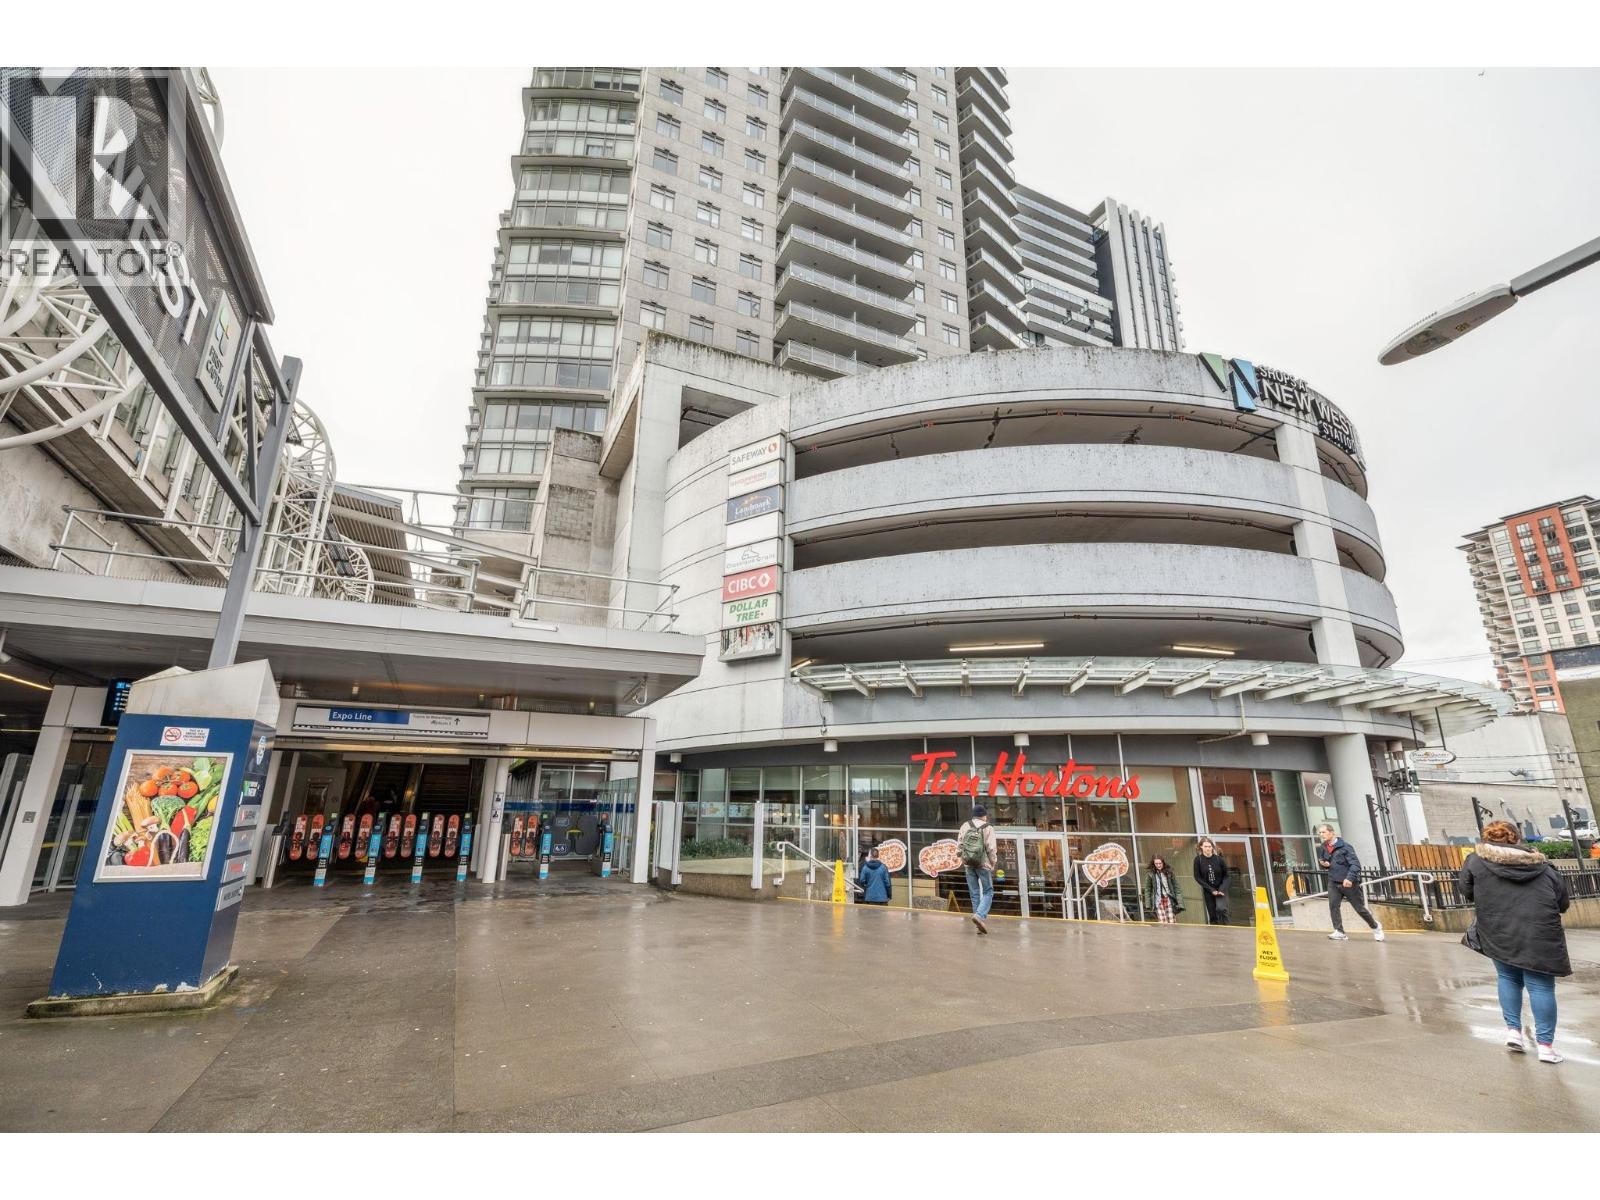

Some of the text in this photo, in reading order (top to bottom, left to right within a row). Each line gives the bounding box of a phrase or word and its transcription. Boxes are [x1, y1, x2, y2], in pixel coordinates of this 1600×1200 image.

[1259, 365, 1297, 388] SHOPS
[1261, 378, 1354, 438] NEW WEST
[731, 446, 767, 466] SAFEWAY
[735, 498, 771, 515] Landmark
[728, 576, 757, 594] CIBC
[729, 598, 769, 614] DOLLAR
[736, 610, 761, 623] TREE
[332, 711, 373, 721] Expo Line
[911, 751, 1141, 799] Tim Hortons
